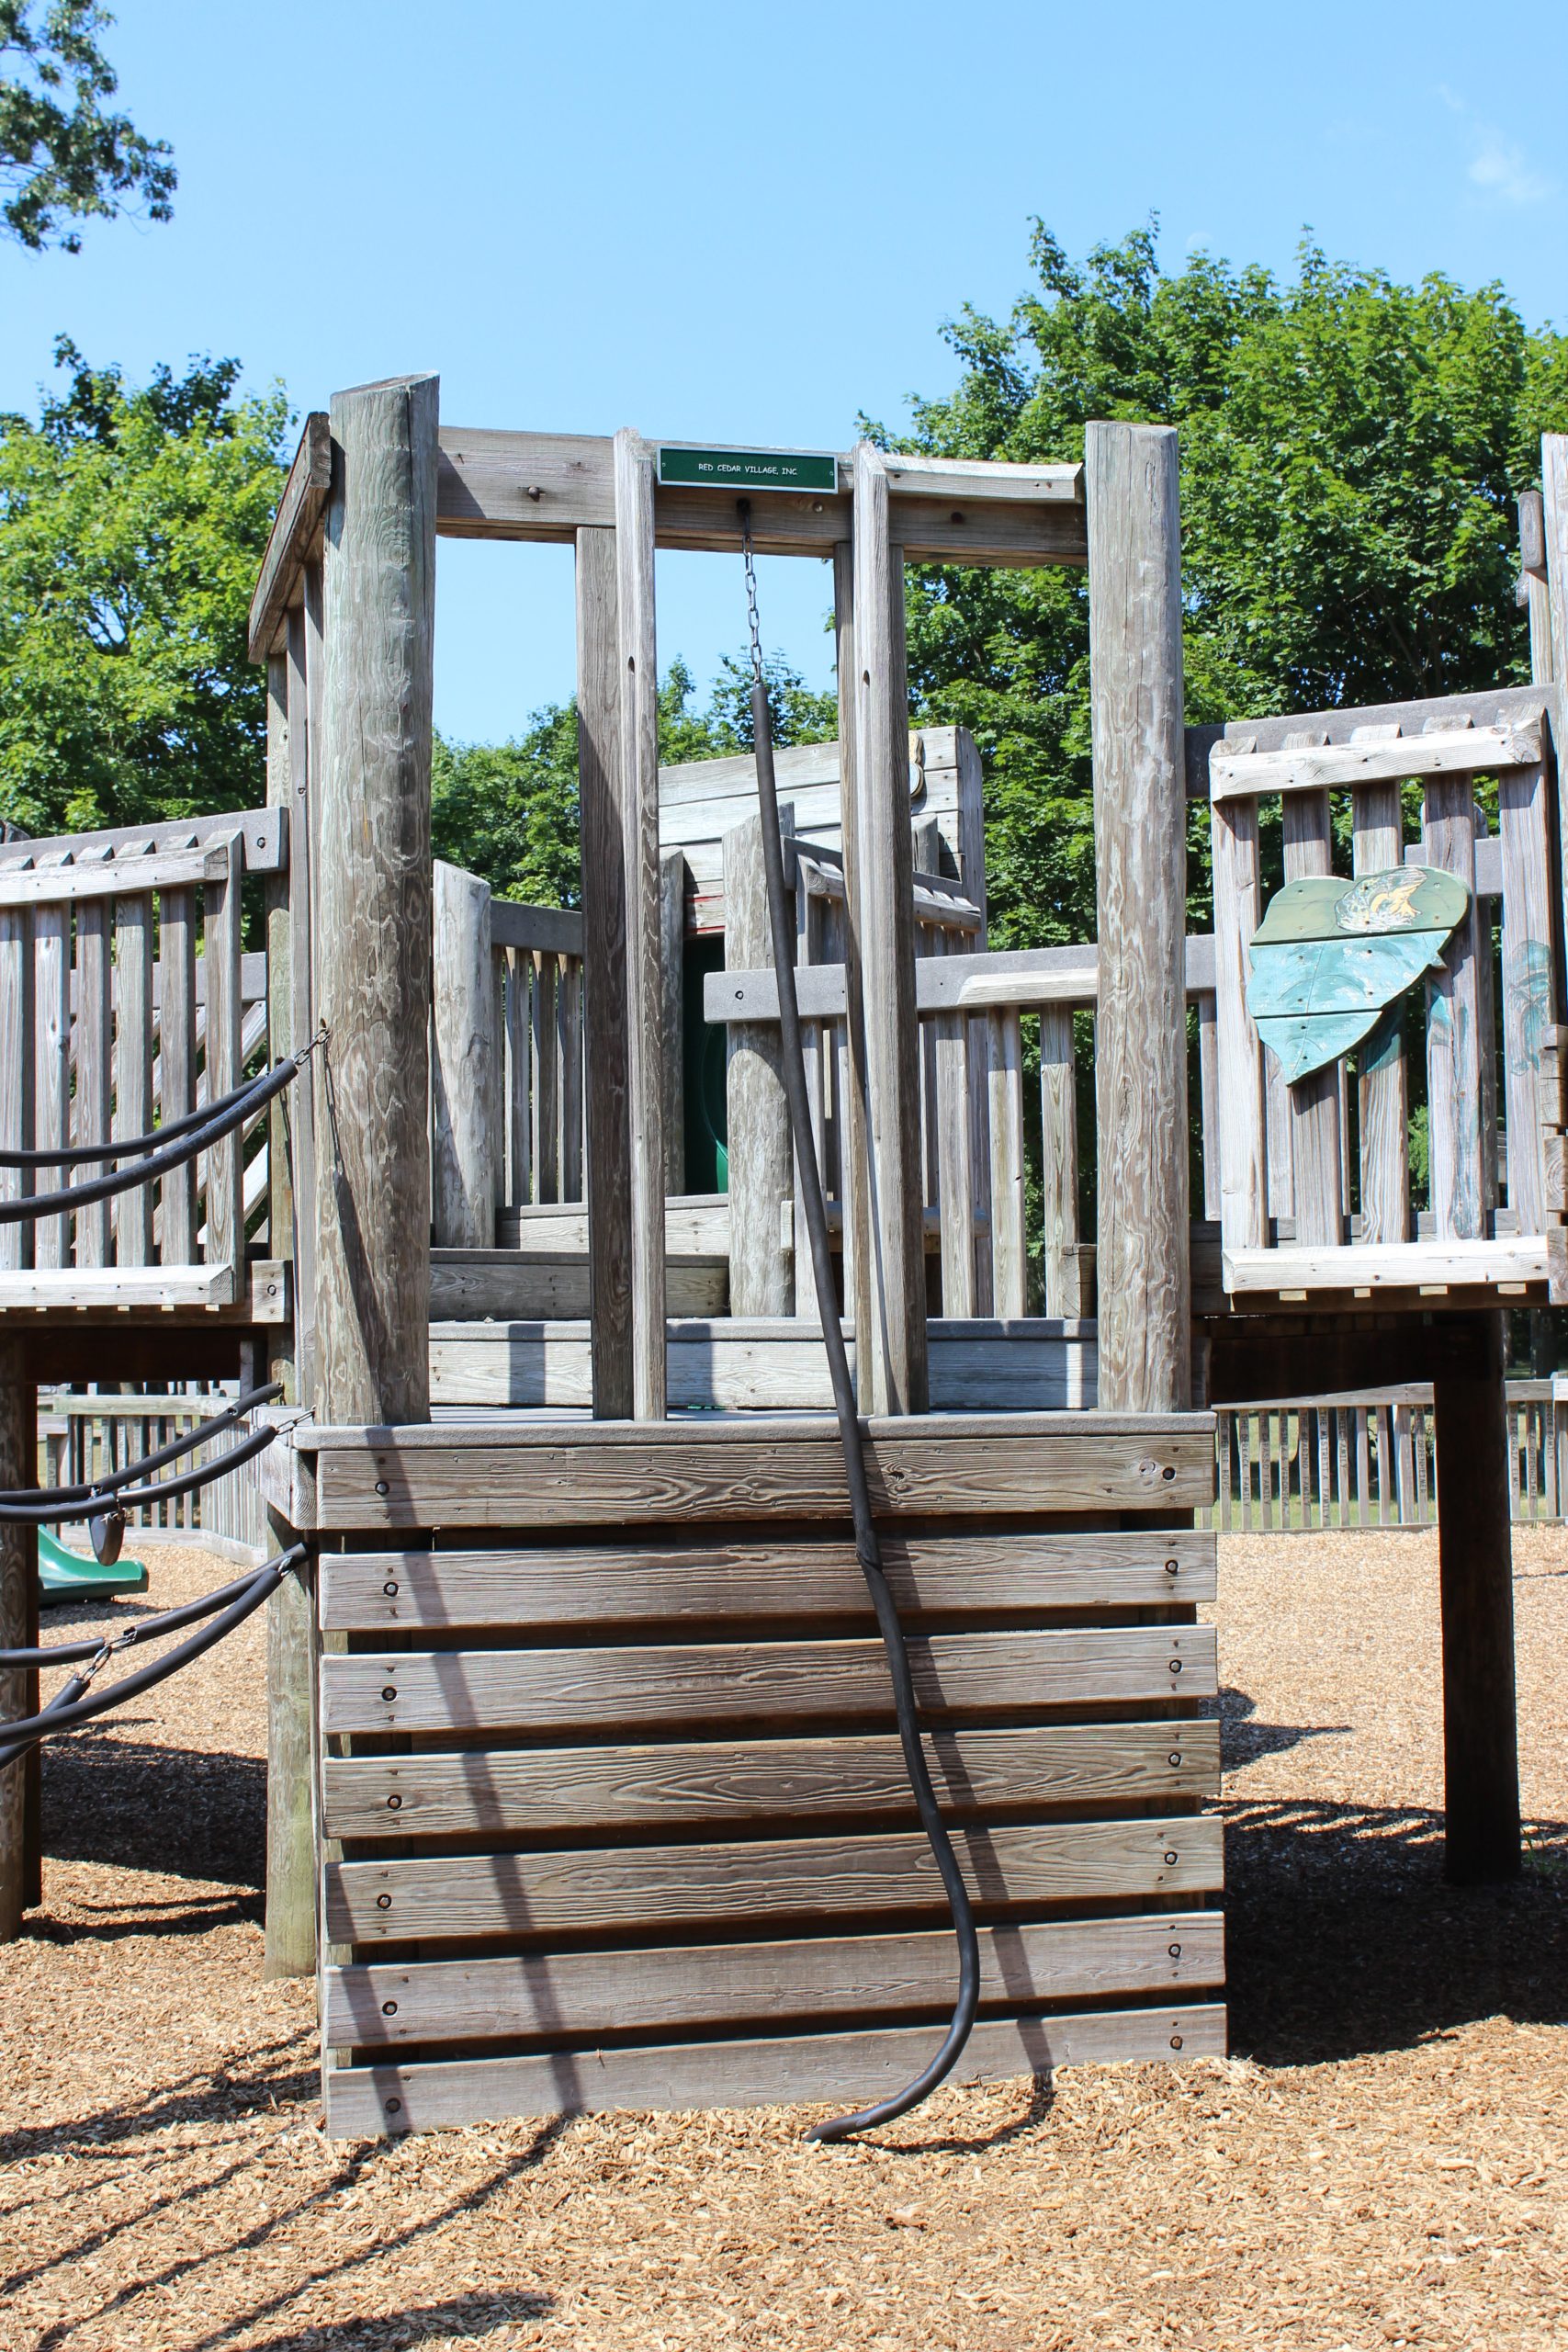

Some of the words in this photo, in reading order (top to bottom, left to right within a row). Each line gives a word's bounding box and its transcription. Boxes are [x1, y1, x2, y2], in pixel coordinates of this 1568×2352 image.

[698, 463, 714, 471] RED
[716, 464, 741, 472] CEDAR
[745, 466, 779, 475] VILLAGE,
[1220, 1416, 1228, 1430] THE
[1240, 1414, 1249, 1430] THE
[1259, 1414, 1269, 1429] THE
[1299, 1412, 1308, 1427] THE
[1319, 1410, 1327, 1426] THE
[1339, 1438, 1348, 1469] FAMILY
[1510, 1426, 1519, 1461] GEORGIA
[1547, 1430, 1555, 1460] FAMILY
[1222, 1469, 1230, 1491] BOYS
[1417, 1439, 1427, 1494] OPPENHEIMER
[1511, 1468, 1519, 1488] ELMS
[1529, 1446, 1538, 1500] OPPENHEIMER
[1242, 1476, 1250, 1508] FAMILY
[1262, 1475, 1271, 1505] FAMILY
[1302, 1476, 1311, 1507] FAMILY
[1321, 1488, 1330, 1519] FAMILY
